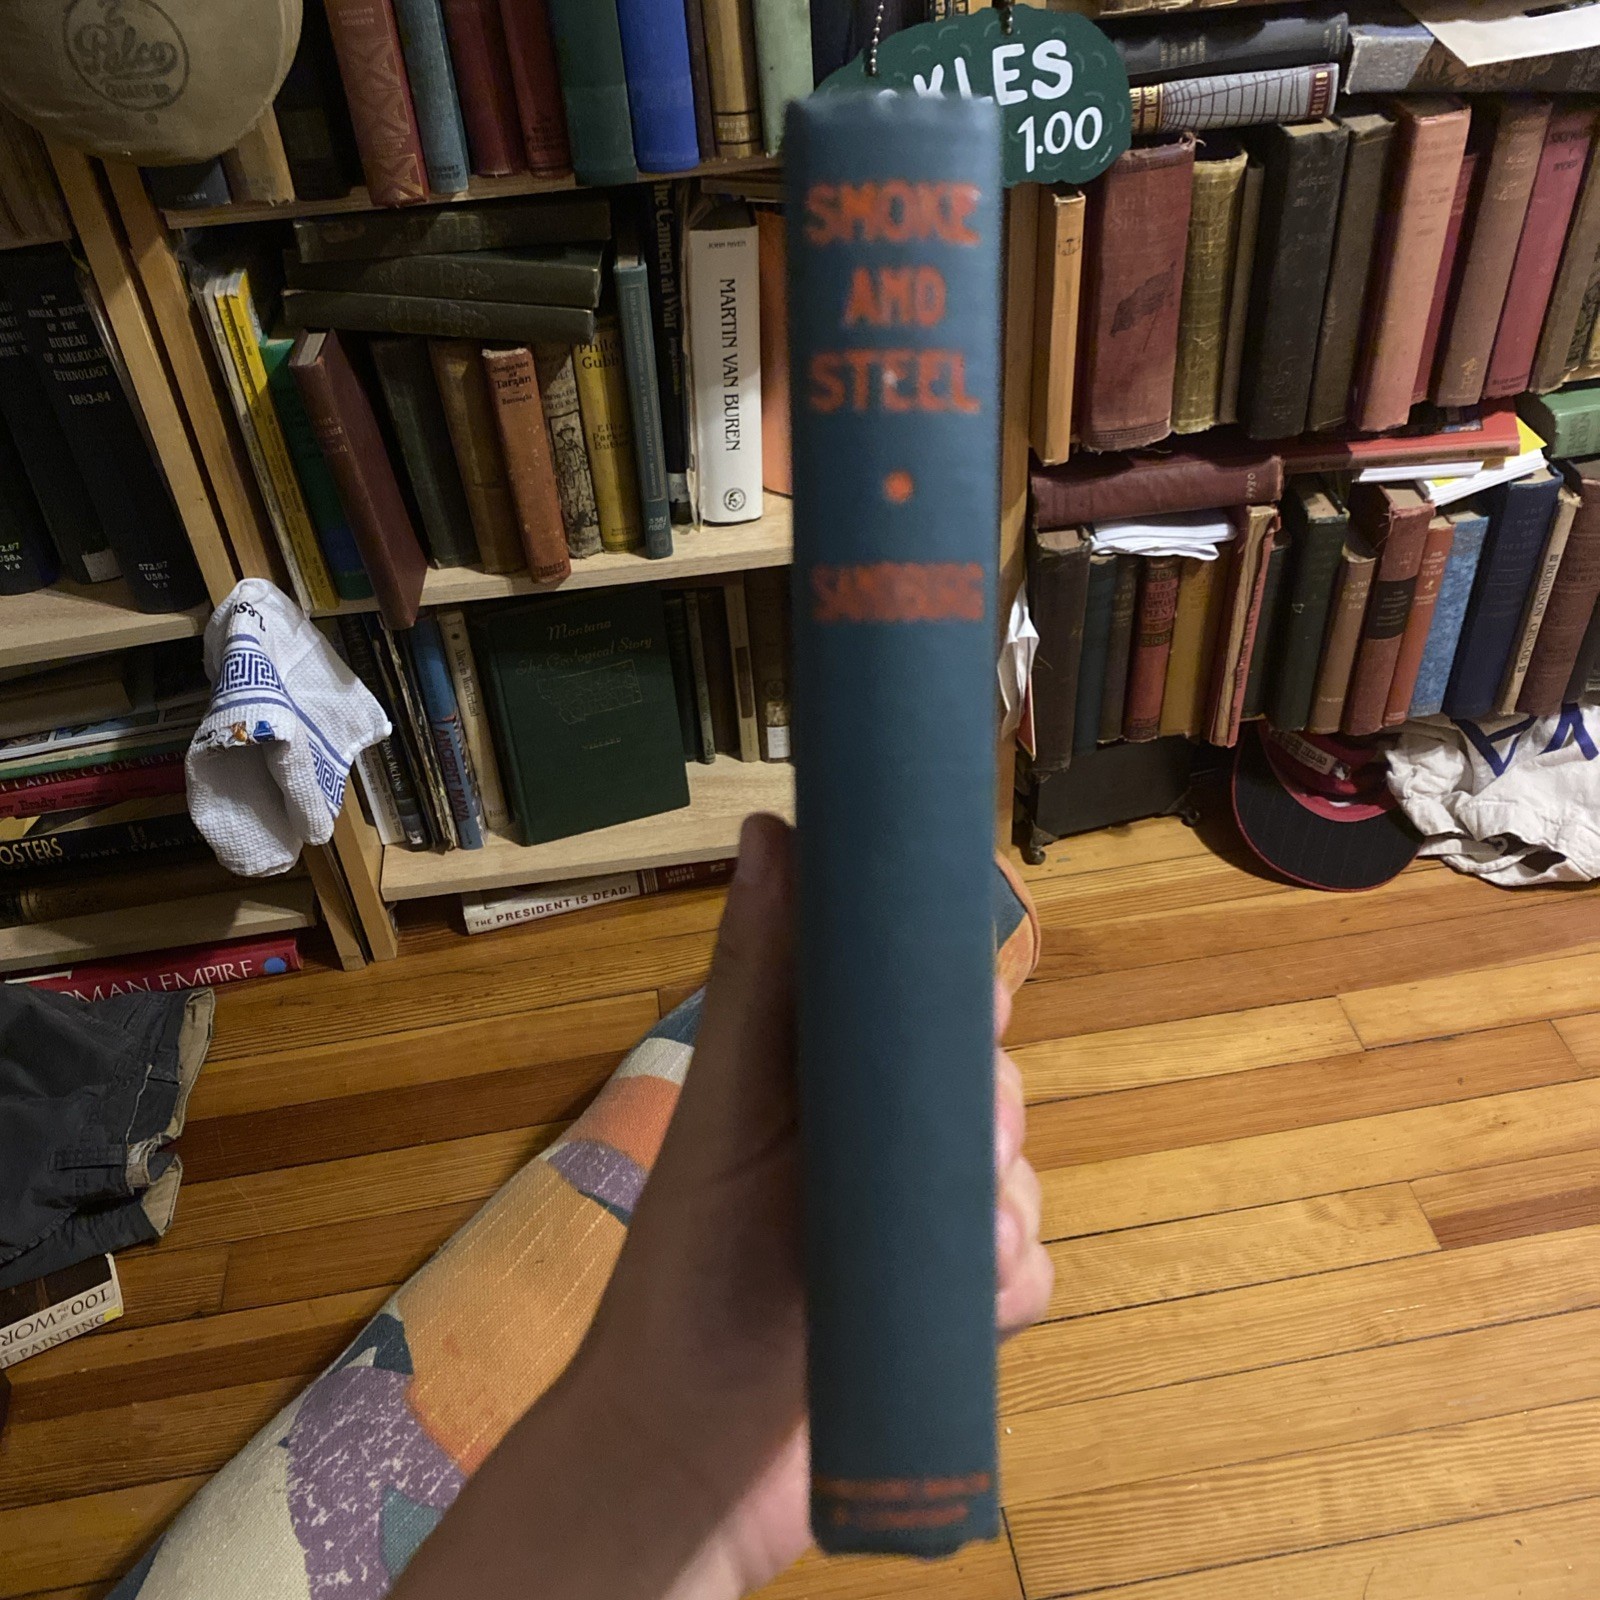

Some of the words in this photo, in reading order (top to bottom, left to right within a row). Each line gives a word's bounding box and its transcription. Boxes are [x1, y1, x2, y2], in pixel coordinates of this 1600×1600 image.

[877, 39, 1073, 106] KLES
[1018, 106, 1103, 173] 1.00
[804, 180, 981, 249] SMOKE
[720, 278, 738, 349] MARTIN
[843, 264, 947, 329] AND
[49, 334, 89, 349] BUREAU
[53, 365, 108, 382] ETHNOLOGY
[495, 375, 532, 389] Tarzan
[722, 355, 739, 388] VAN
[807, 346, 981, 415] STEEL
[724, 393, 741, 451] BUREN
[475, 918, 492, 927] THE
[496, 898, 571, 924] PRESIDENT
[576, 895, 588, 906] IS
[592, 885, 632, 902] DEAD!
[59, 977, 152, 1003] MAN
[158, 959, 254, 991] EMPIRE
